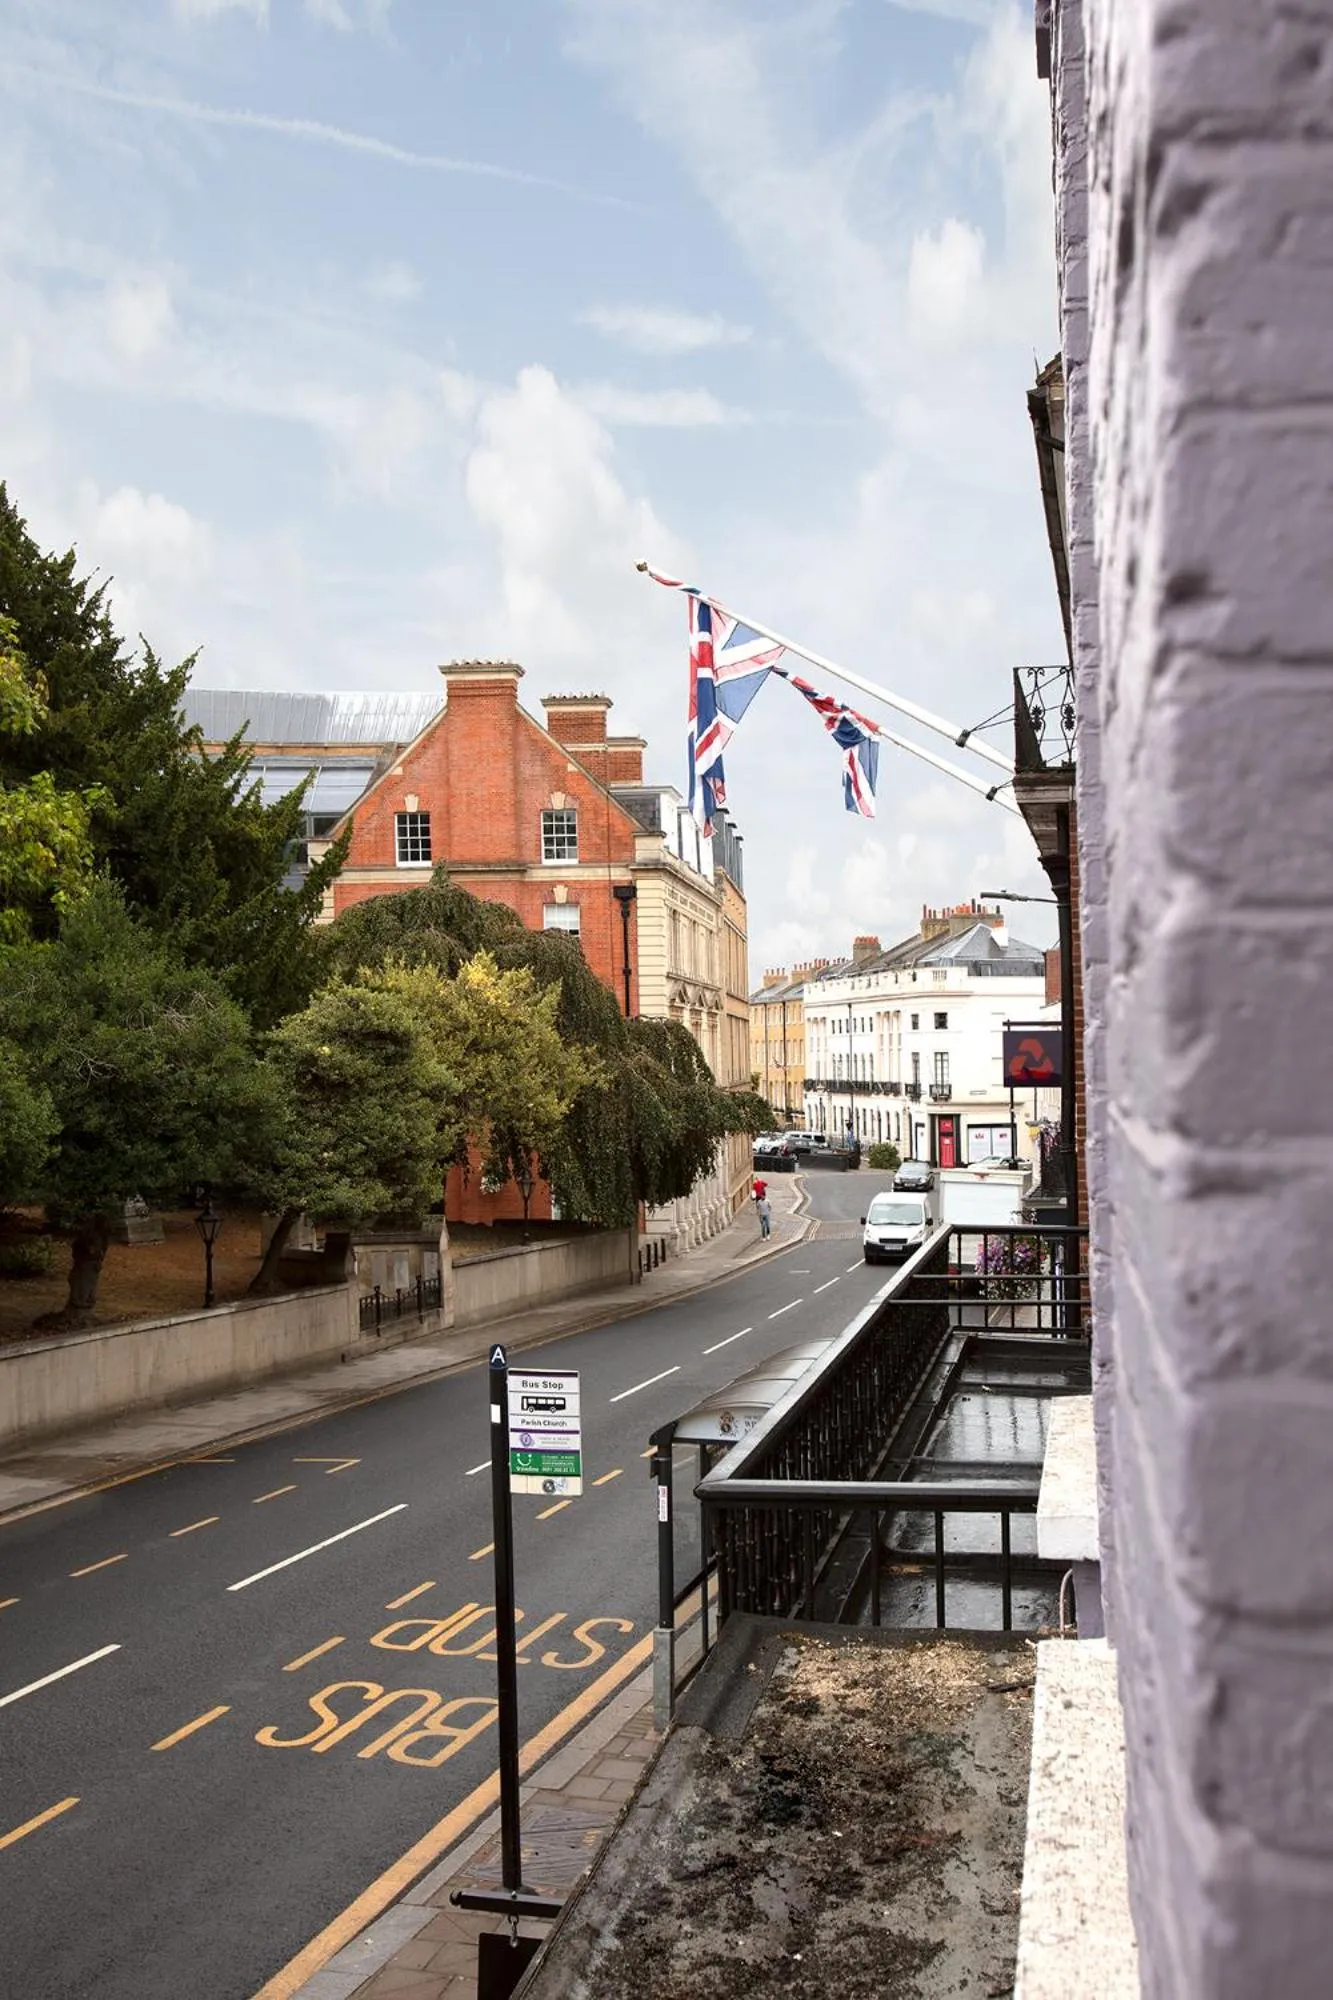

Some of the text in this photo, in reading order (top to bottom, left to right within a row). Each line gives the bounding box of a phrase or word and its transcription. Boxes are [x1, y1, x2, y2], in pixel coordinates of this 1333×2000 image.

[491, 1346, 505, 1364] A
[522, 1380, 564, 1390] Bus Stop
[370, 1603, 634, 1668] STOP
[255, 1681, 500, 1767] BUS
